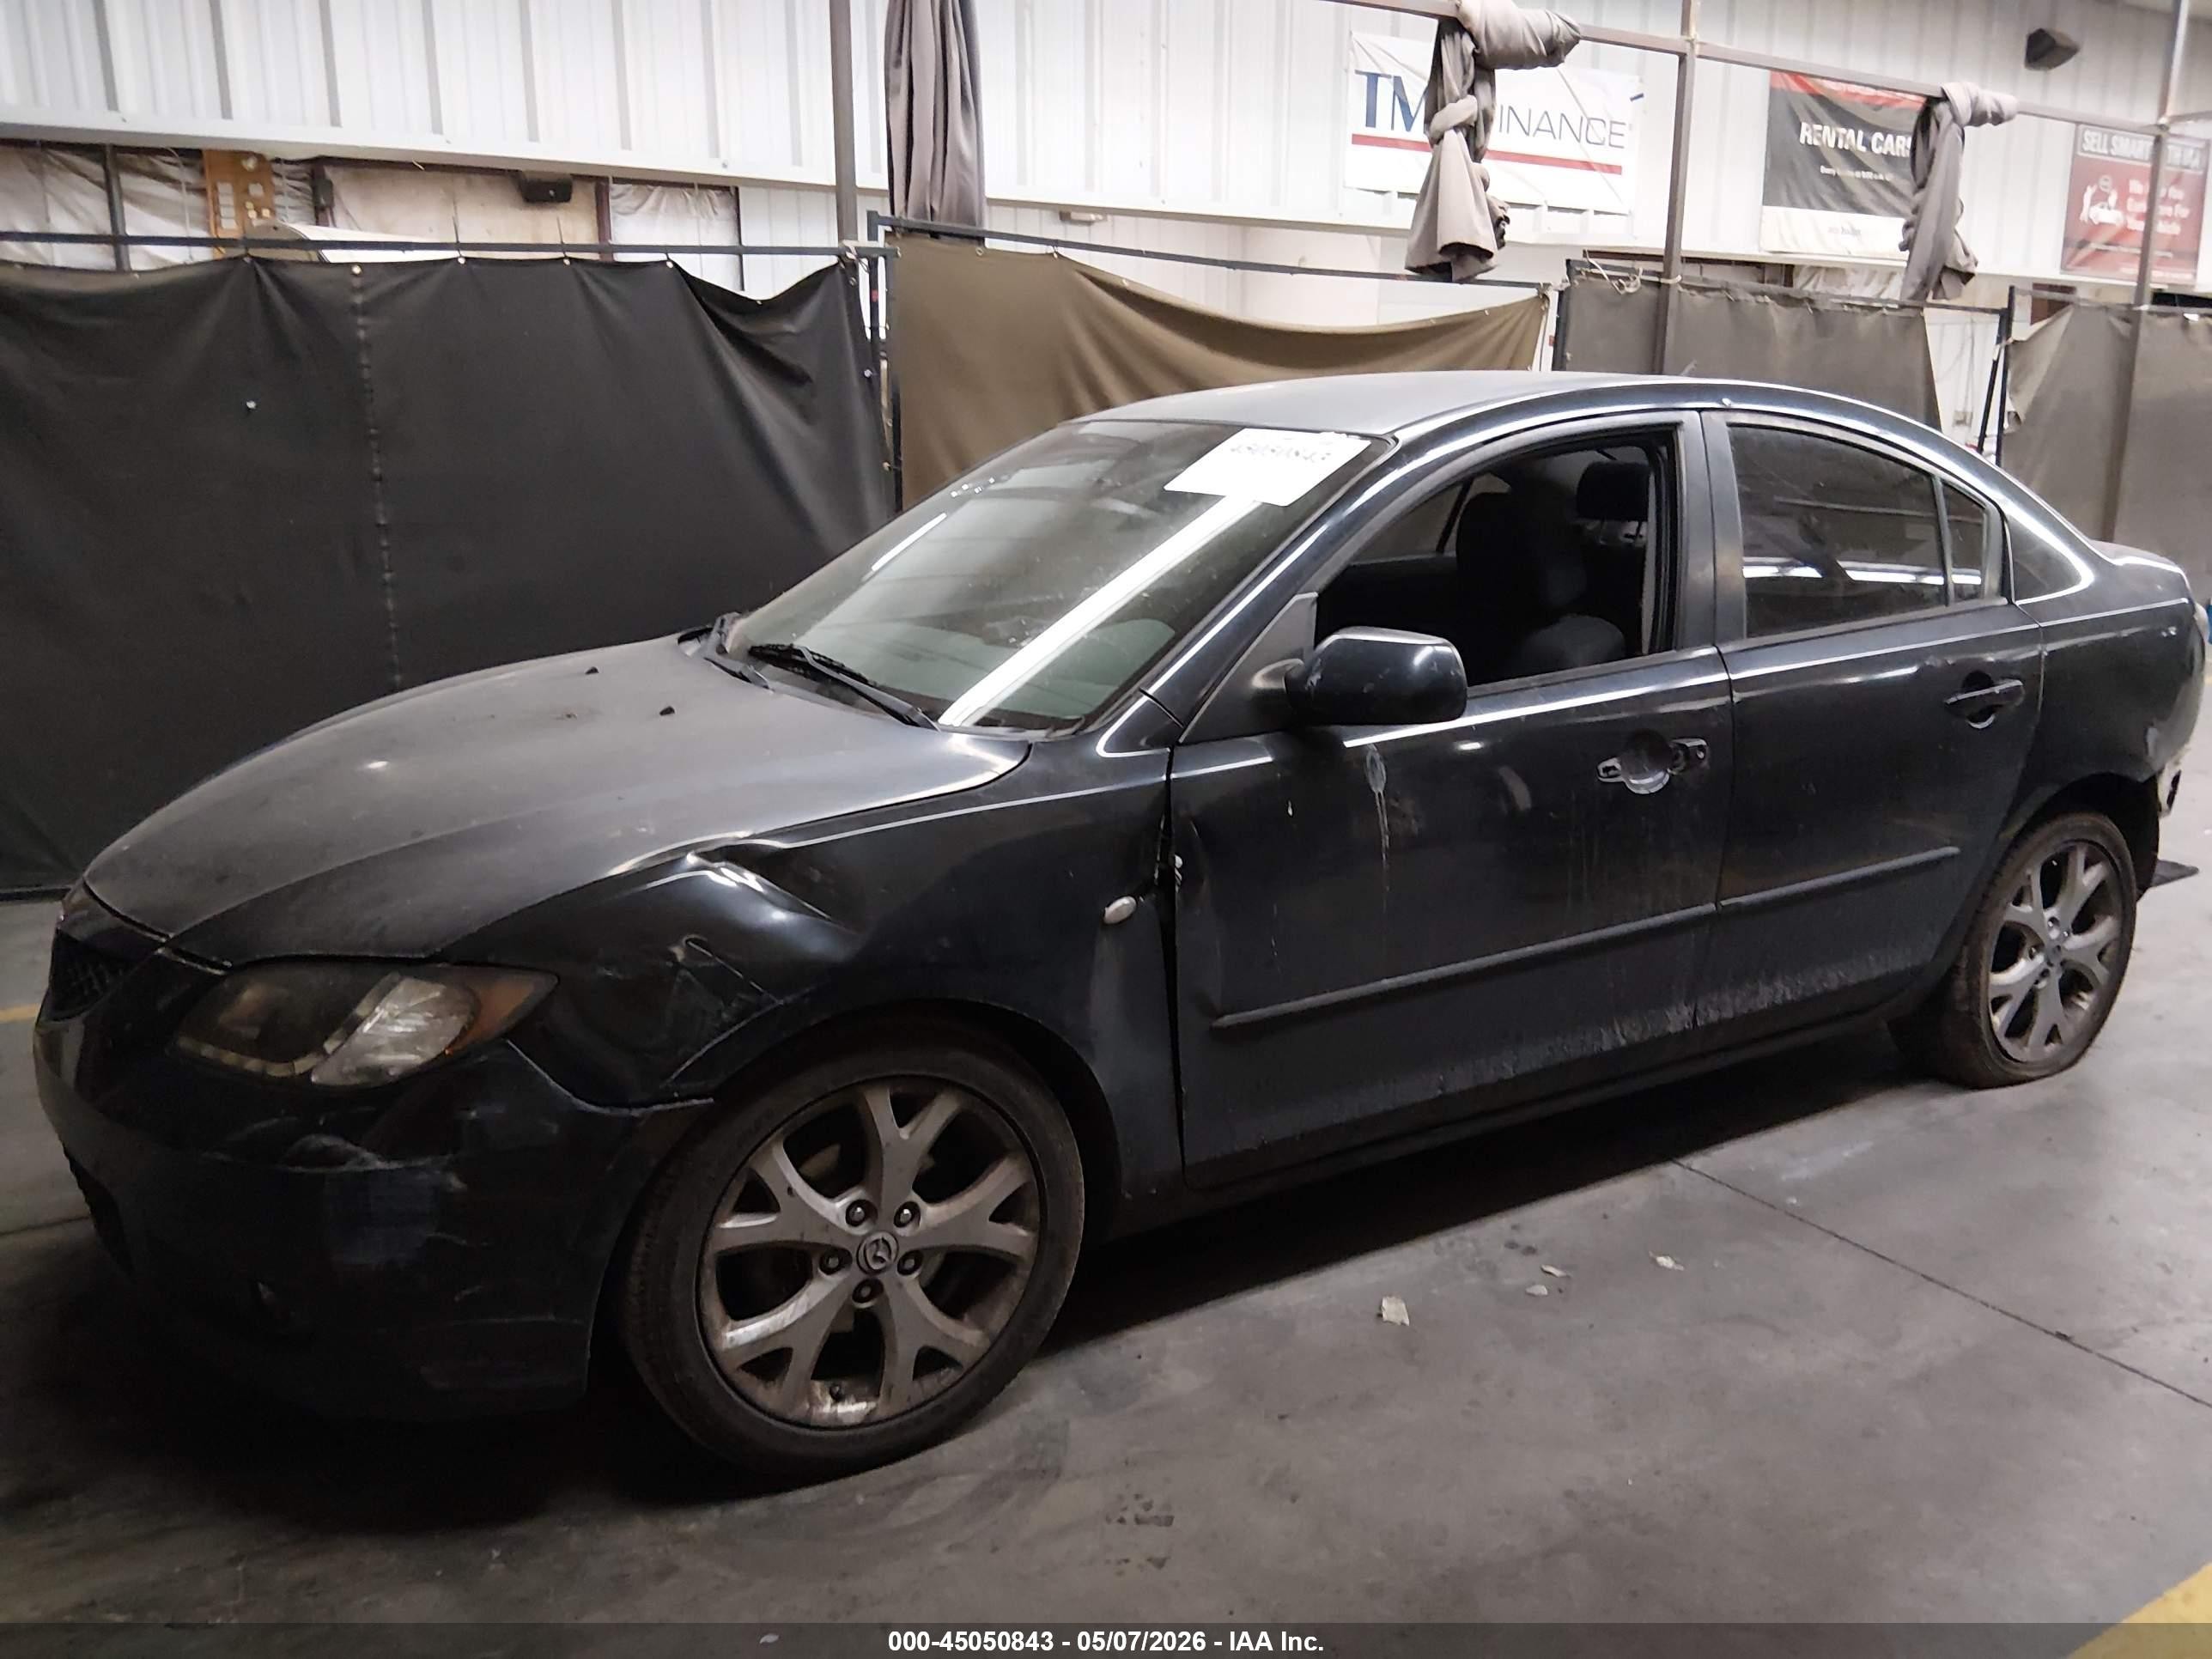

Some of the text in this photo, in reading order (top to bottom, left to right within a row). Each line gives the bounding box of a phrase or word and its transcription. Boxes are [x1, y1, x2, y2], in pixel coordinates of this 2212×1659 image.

[1354, 69, 1627, 149] TM INANCE
[1799, 121, 1867, 152] RENTAL
[2082, 129, 2108, 155] SELL
